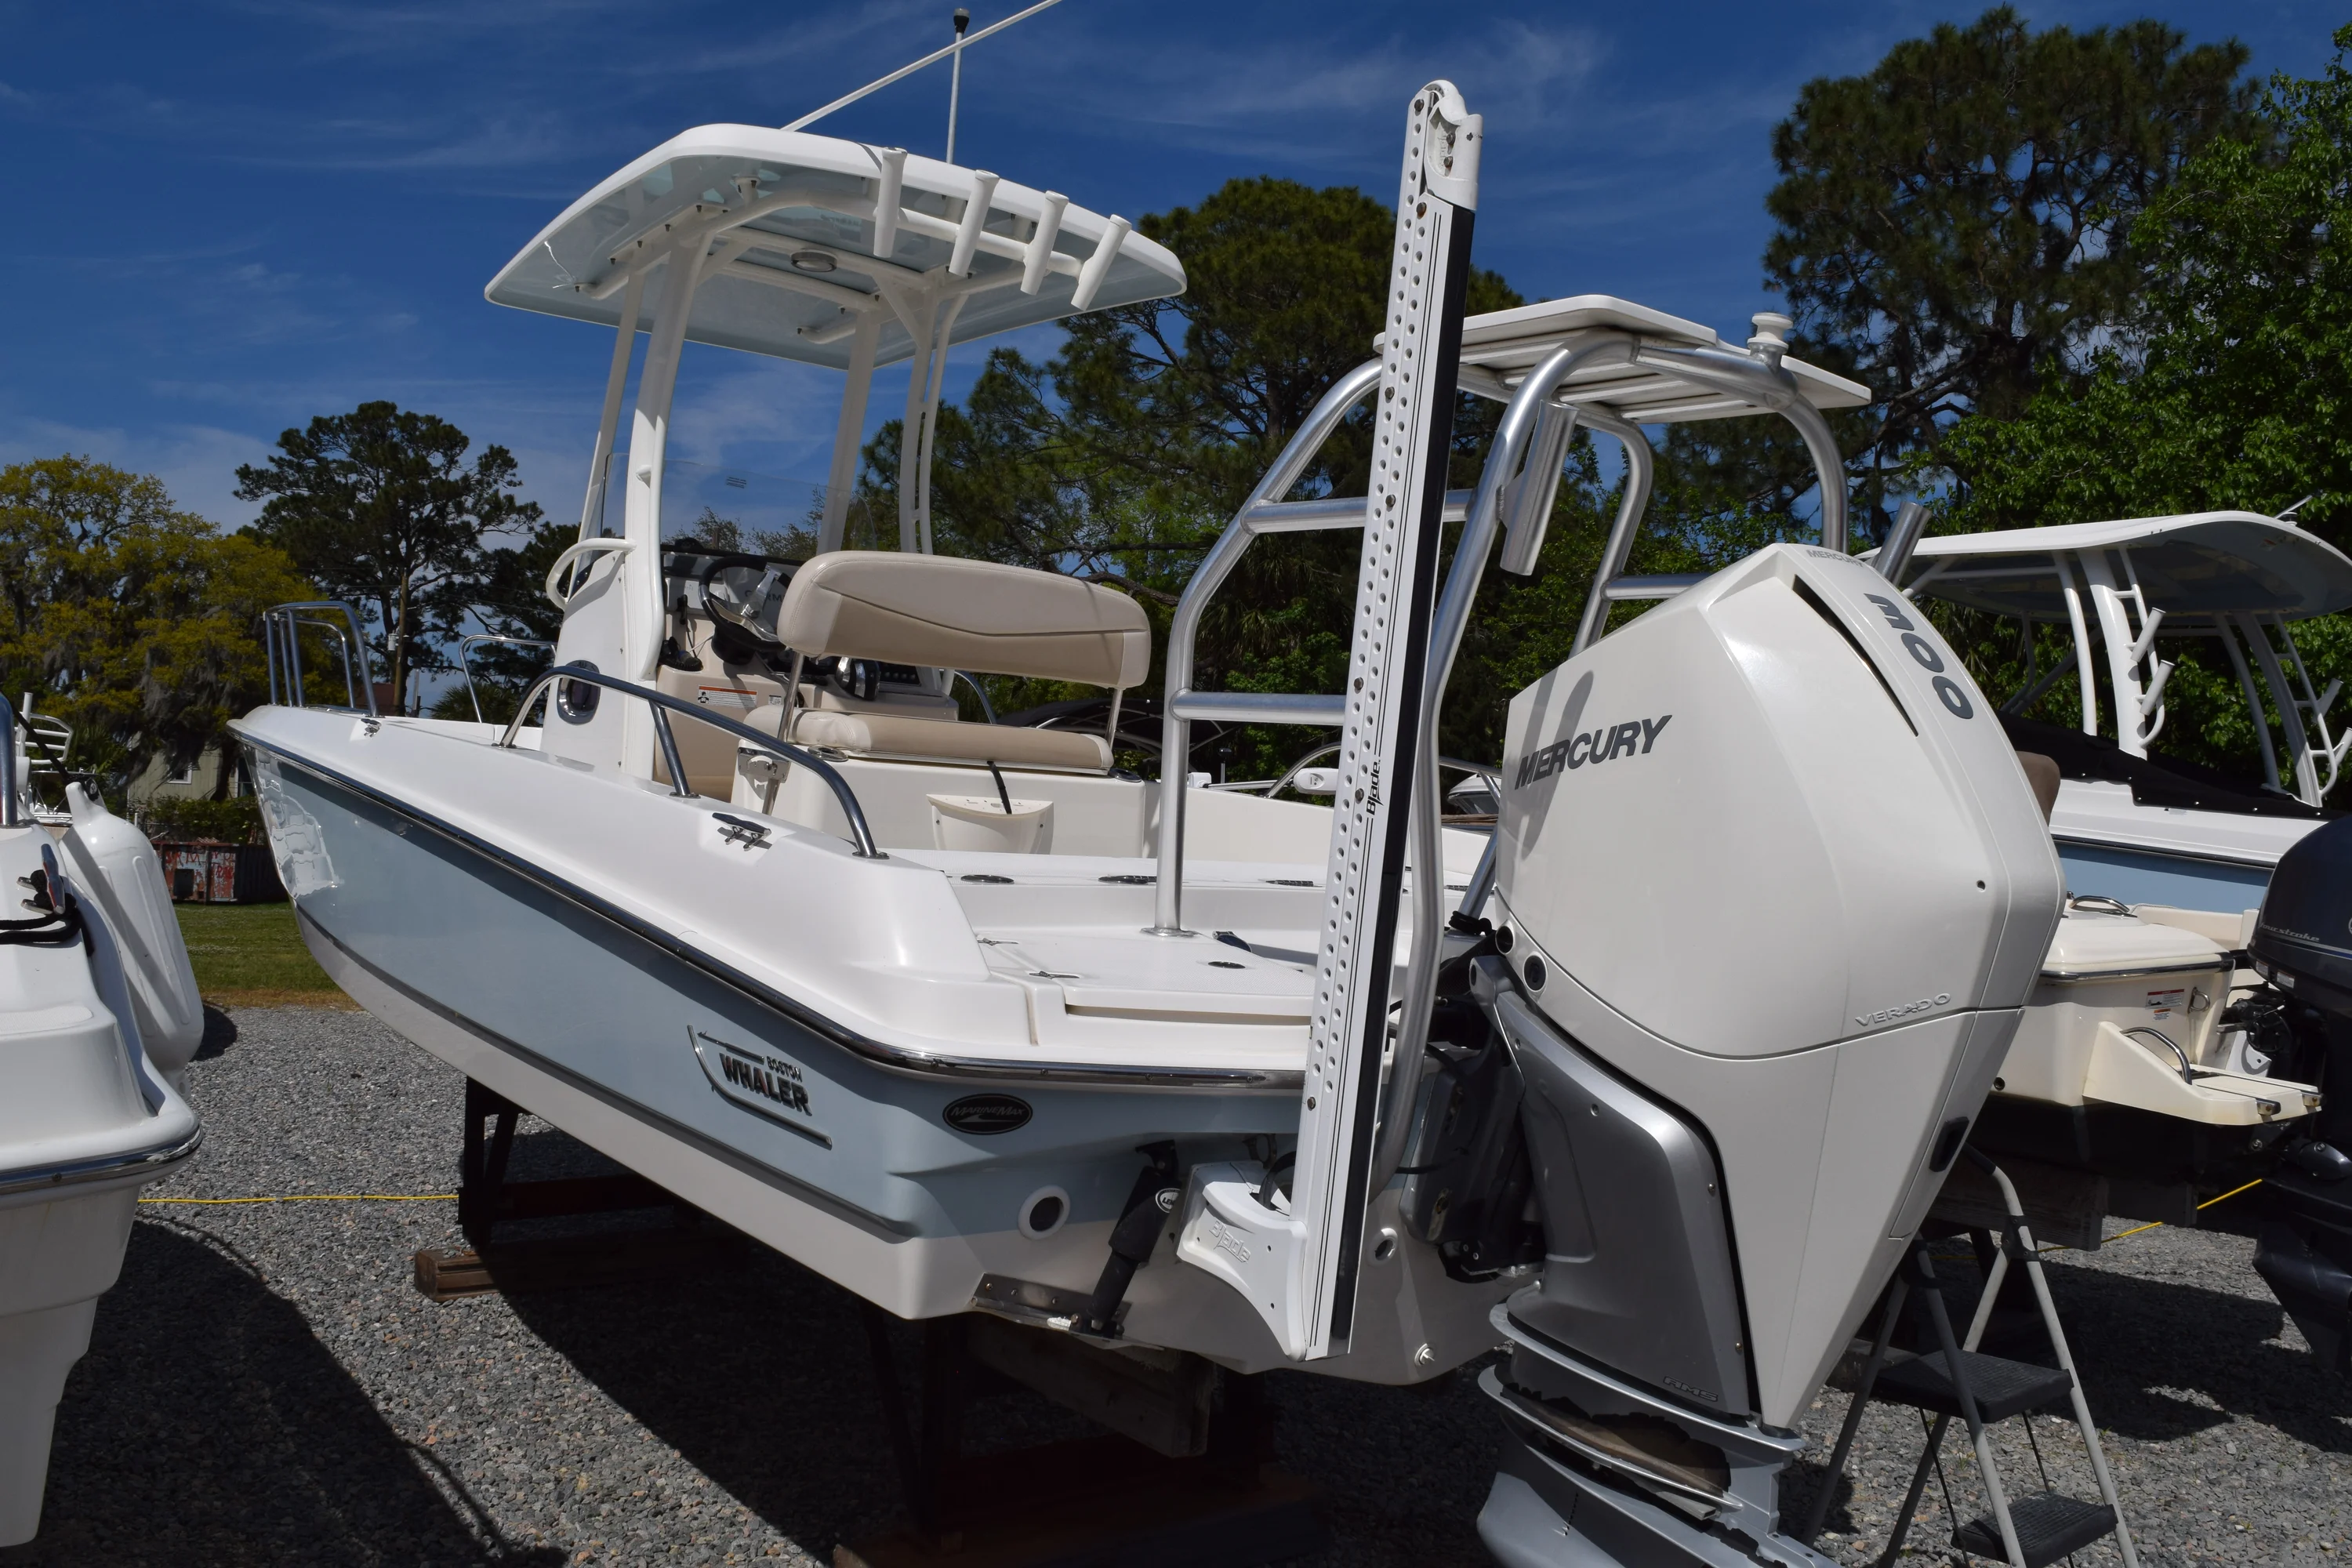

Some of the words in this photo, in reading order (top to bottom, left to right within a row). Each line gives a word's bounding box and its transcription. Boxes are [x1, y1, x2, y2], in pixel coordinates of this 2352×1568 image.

[1806, 550, 1863, 567] MERCURY
[1863, 593, 1974, 720] 300
[1514, 714, 1673, 790] MERCURY
[1366, 761, 1384, 815] Blade
[1854, 993, 1951, 1027] VERADO
[719, 1052, 812, 1116] WHALER
[766, 1055, 803, 1083] BOSTON
[1208, 1220, 1252, 1264] Blade
